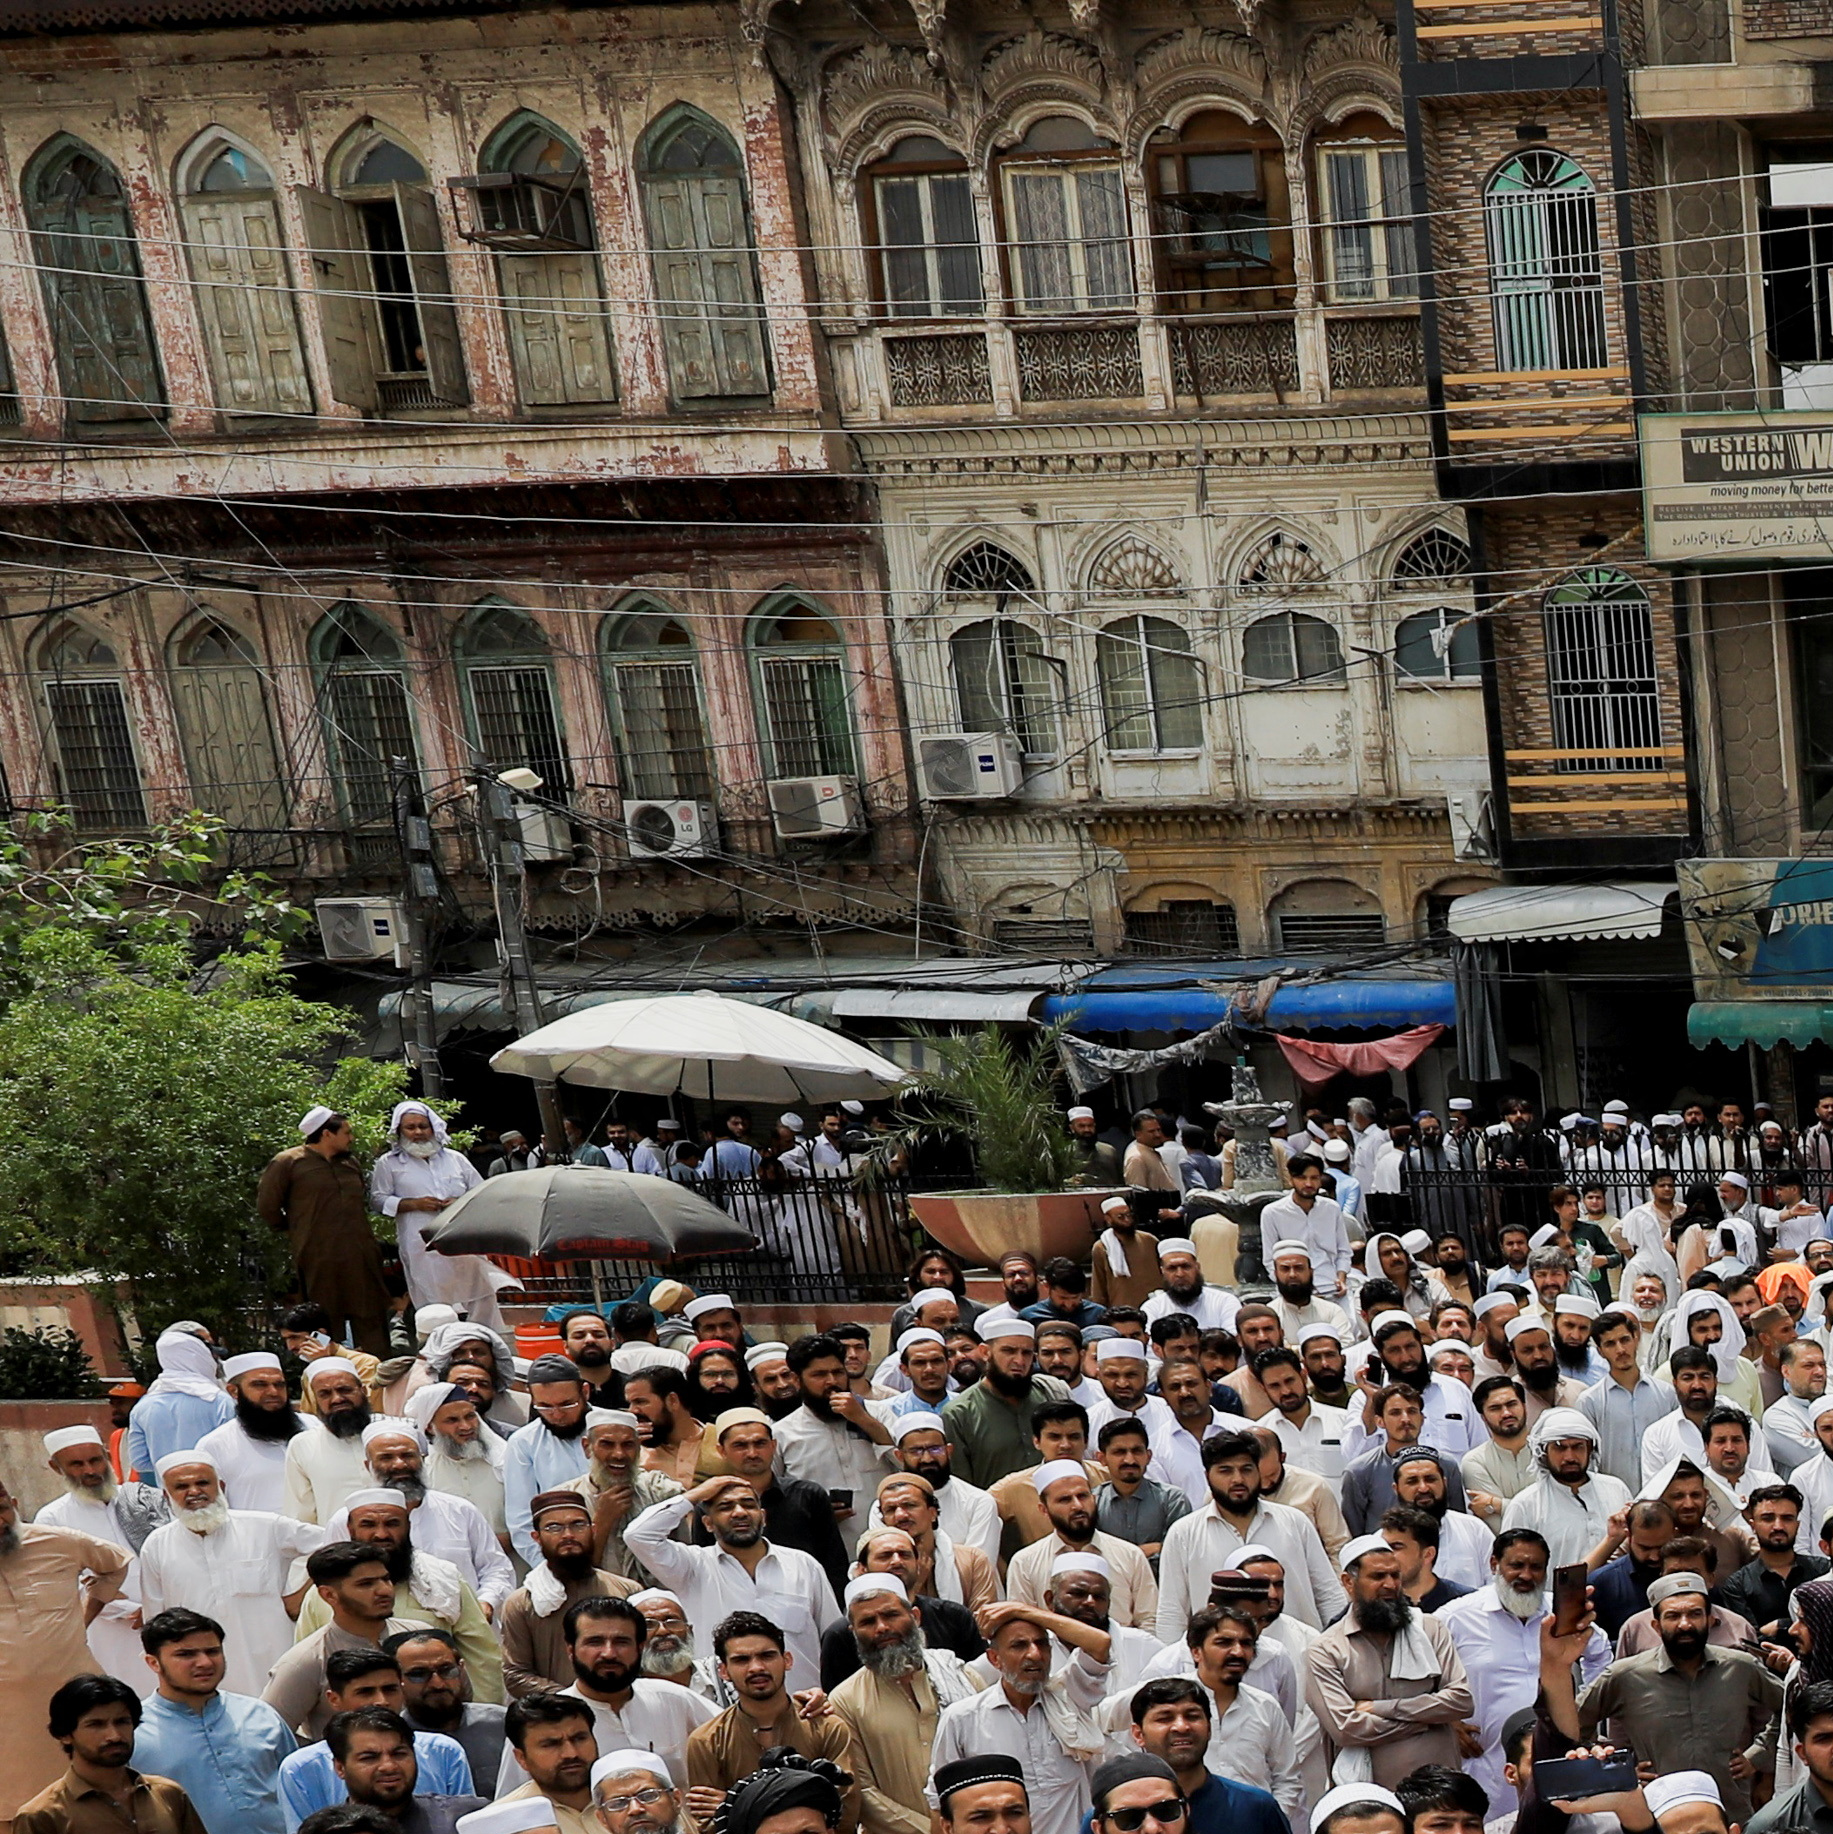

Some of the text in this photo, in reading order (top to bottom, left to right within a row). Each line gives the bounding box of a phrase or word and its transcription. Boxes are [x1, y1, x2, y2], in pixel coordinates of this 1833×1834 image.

[1690, 433, 1784, 454] WESTERN
[1721, 453, 1785, 471] UNION
[1711, 486, 1749, 498] moving
[1751, 485, 1786, 497] money
[1789, 481, 1804, 494] for
[681, 824, 693, 832] LG
